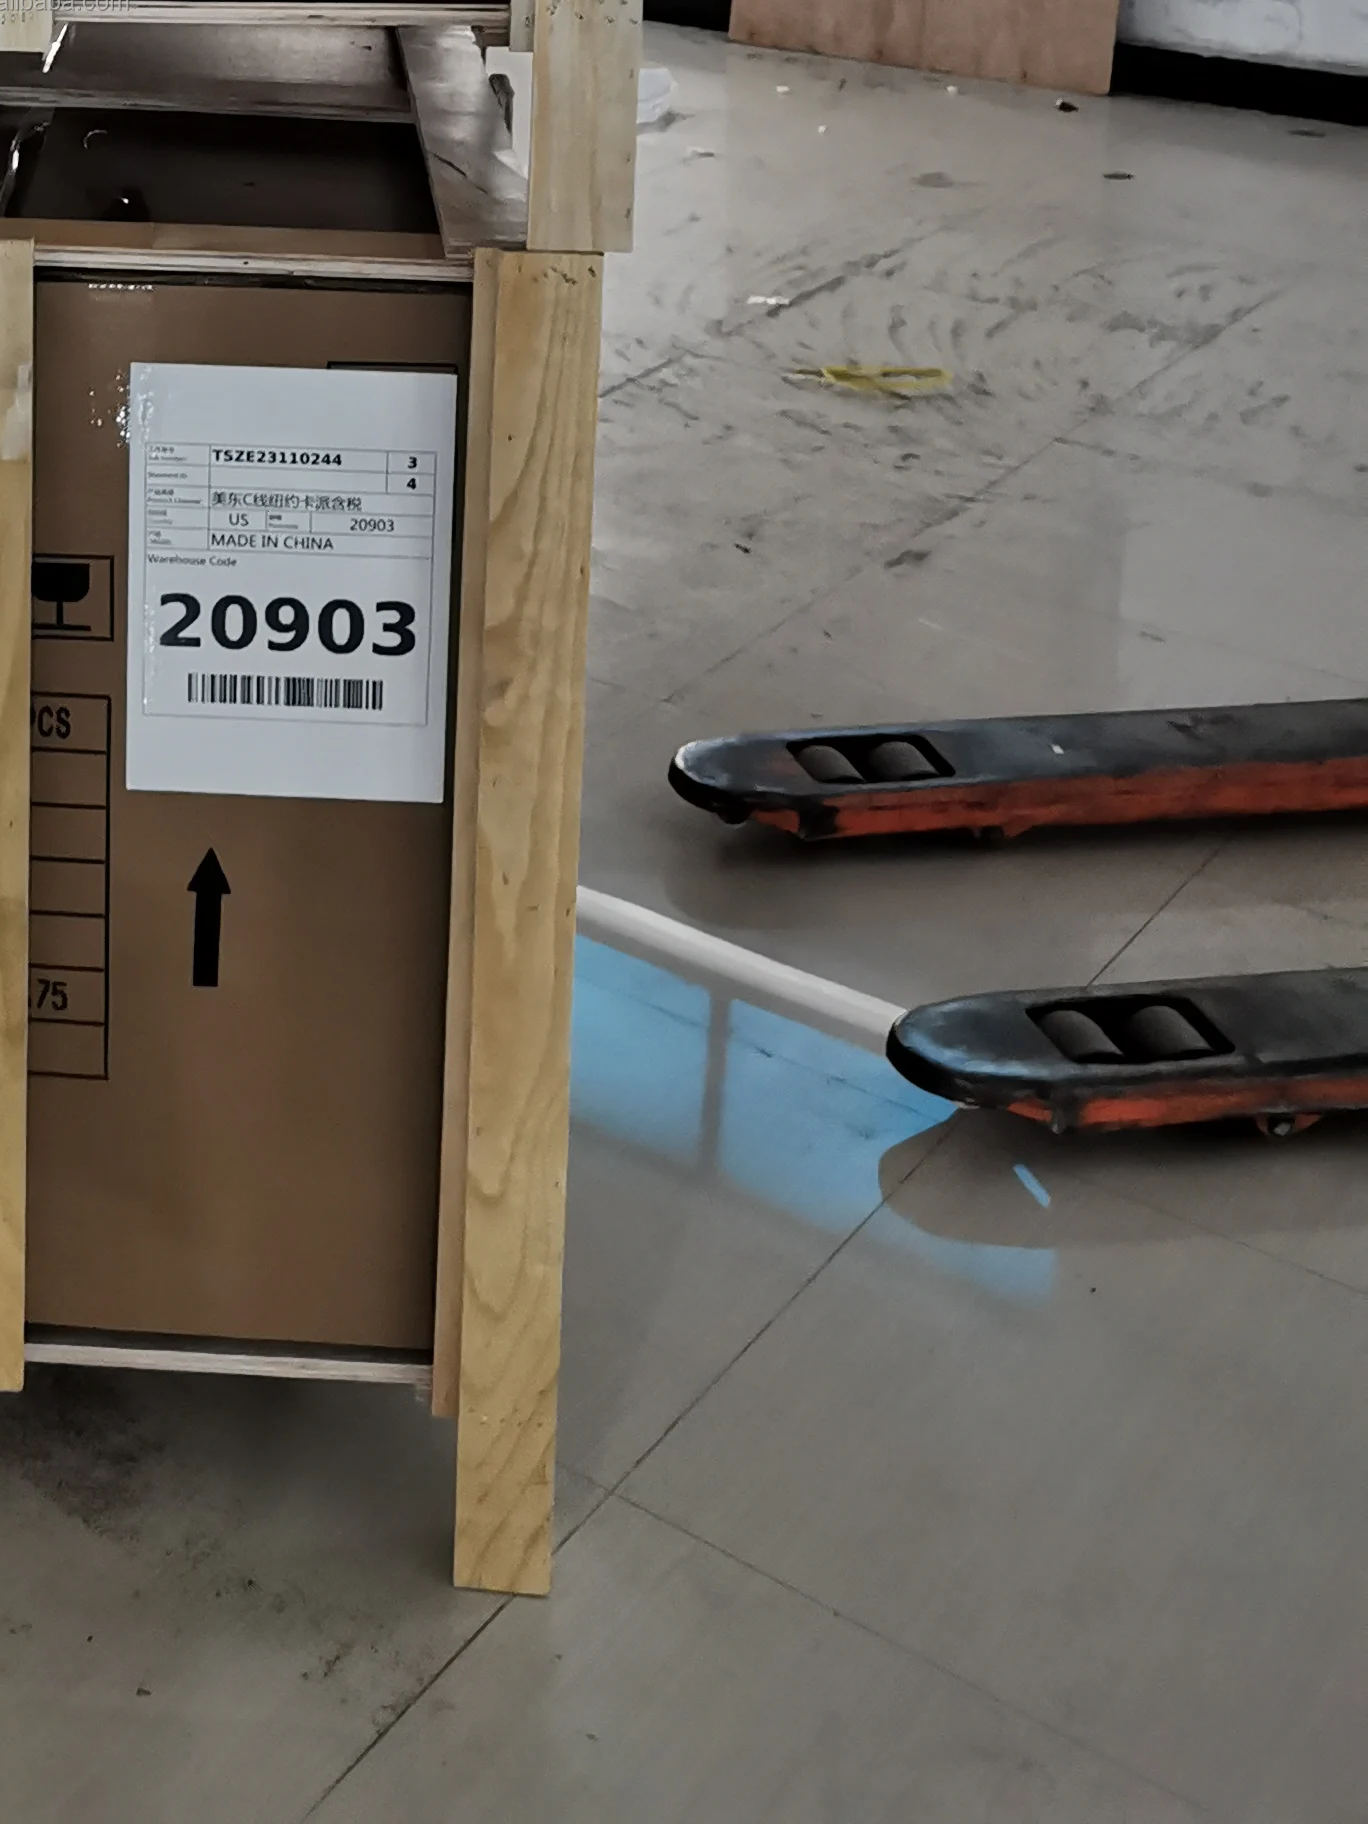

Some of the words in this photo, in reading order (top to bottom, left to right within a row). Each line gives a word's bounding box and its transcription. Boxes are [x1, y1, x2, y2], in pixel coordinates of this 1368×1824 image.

[212, 449, 343, 467] TSZE23110244
[407, 456, 418, 469] 3
[406, 477, 418, 491] 4
[229, 513, 249, 527] US
[350, 518, 395, 533] 20903
[211, 533, 257, 549] MADE
[261, 535, 278, 549] IN
[283, 535, 334, 550] CHINA
[147, 553, 206, 566] Warehouse
[209, 555, 237, 567] Code
[159, 592, 416, 656] 20903
[31, 706, 71, 739] CS
